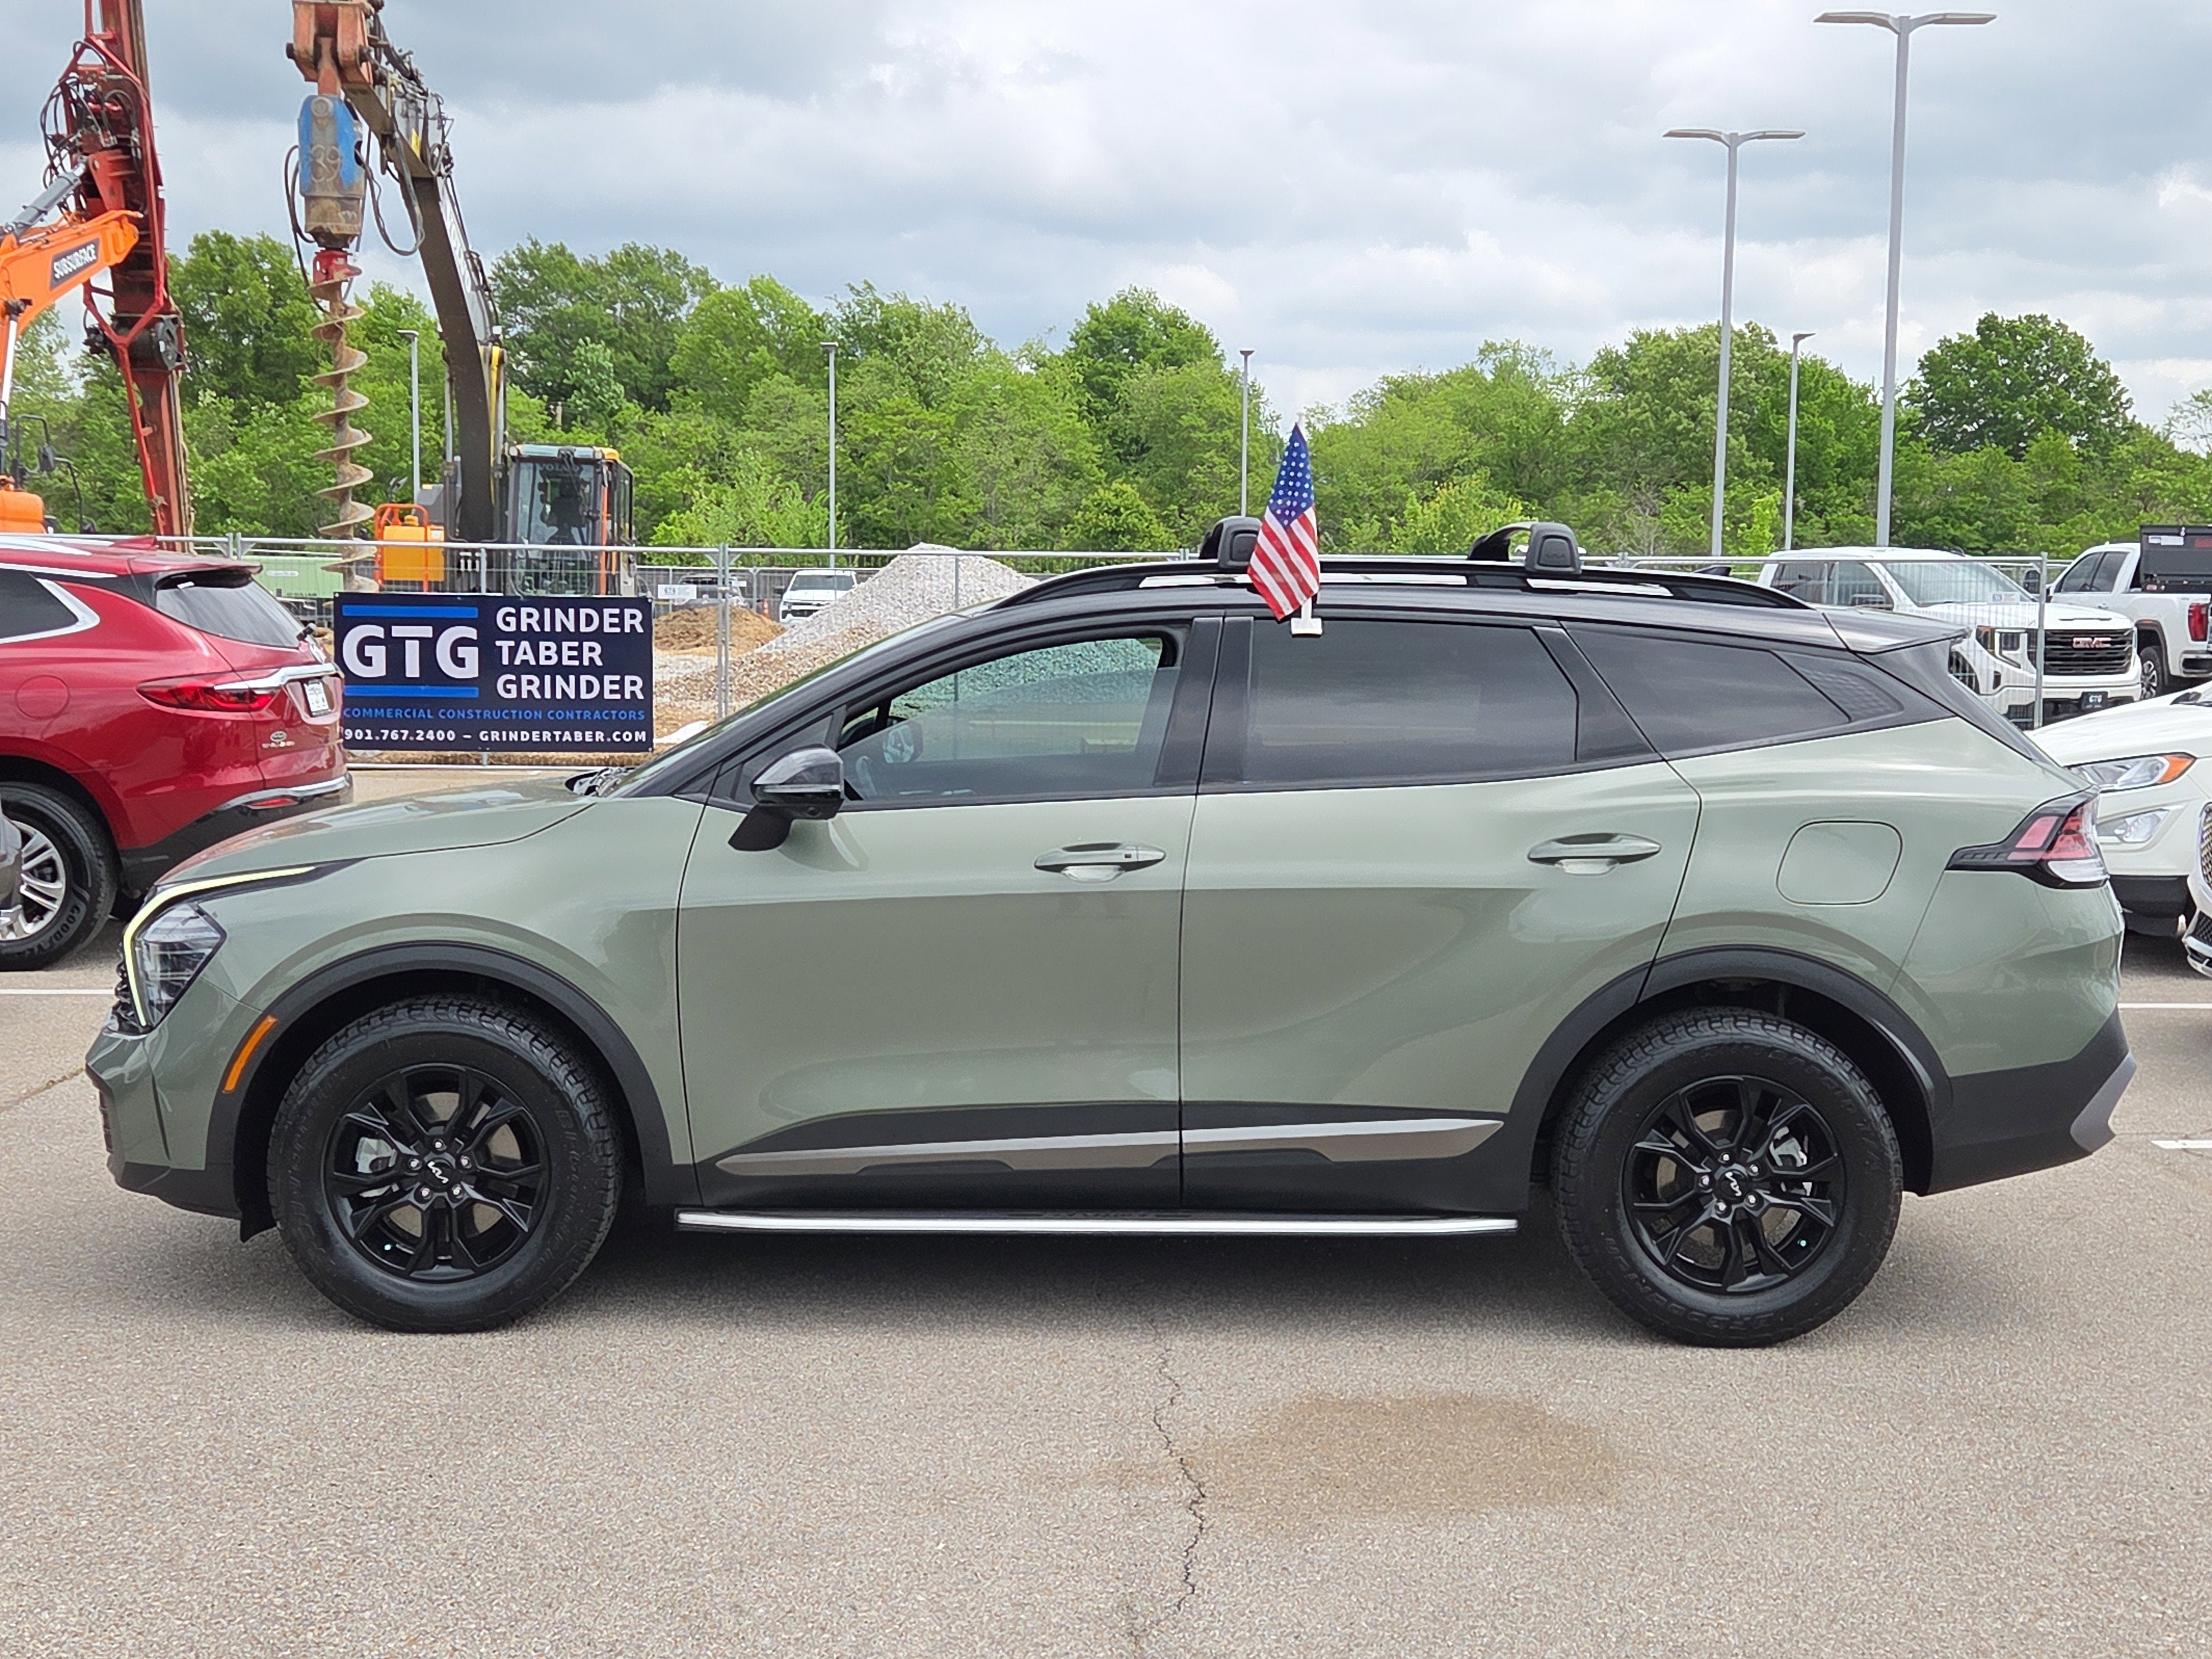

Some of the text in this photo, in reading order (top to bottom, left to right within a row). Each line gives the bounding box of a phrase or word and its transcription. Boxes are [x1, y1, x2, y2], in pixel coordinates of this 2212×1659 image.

[496, 607, 644, 633] GRINDER
[343, 625, 479, 678] GTG
[495, 640, 603, 666] TABER
[497, 674, 645, 699] GRINDER
[343, 708, 645, 720] COMMERCIAL CONSTRUCTION CONTRACTORS
[344, 729, 455, 742] 901.767.2400
[479, 730, 646, 742] GRINDERTABER.COM
